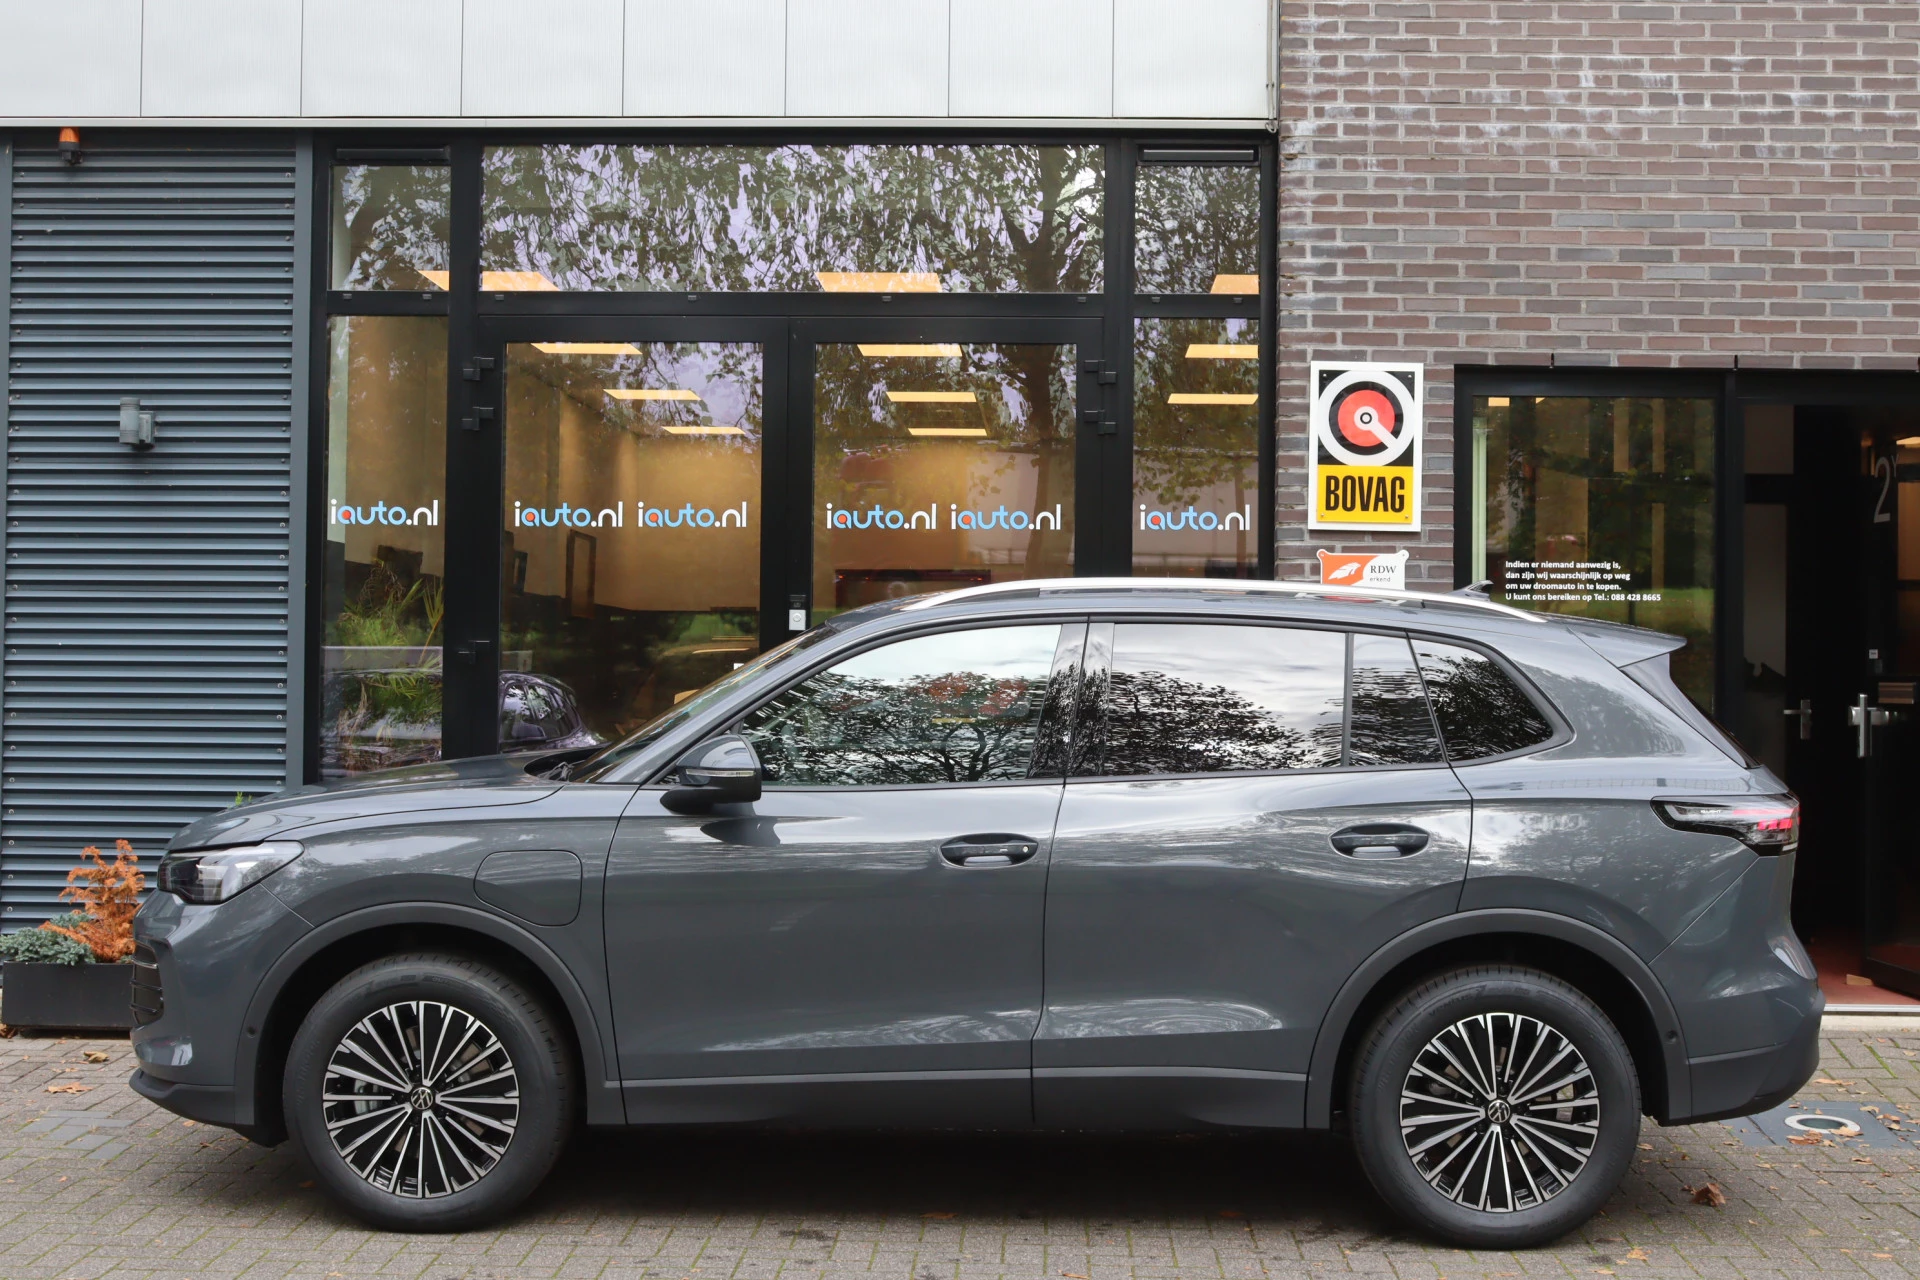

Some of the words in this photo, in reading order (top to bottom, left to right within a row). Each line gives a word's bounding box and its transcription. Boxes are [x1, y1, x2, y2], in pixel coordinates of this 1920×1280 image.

[1325, 475, 1405, 513] BOVAG
[330, 498, 439, 526] iauto.nl
[514, 500, 623, 528] iauto.nl
[637, 501, 747, 528] iauto.nl
[826, 502, 937, 530] iauto.nl
[950, 503, 1061, 530] iauto.nl
[1139, 503, 1251, 531] iauto.nl
[1370, 565, 1396, 574] RDW
[1541, 561, 1574, 569] niemand
[1576, 561, 1611, 570] aanwezig
[1613, 561, 1621, 569] is,
[1505, 571, 1520, 579] dan
[1521, 571, 1535, 580] zijn
[1536, 571, 1549, 580] wij
[1550, 571, 1601, 580] waarschijnlijk
[1614, 573, 1631, 581] weg
[1533, 582, 1576, 590] droomauto
[1596, 582, 1622, 591] kopen.
[1513, 592, 1531, 600] kunt
[1547, 592, 1580, 601] bereiken
[1582, 594, 1592, 602] op
[1594, 593, 1609, 601] Tel.:
[1611, 593, 1625, 601] 088
[1627, 593, 1641, 601] 428
[1642, 593, 1661, 601] 8665
